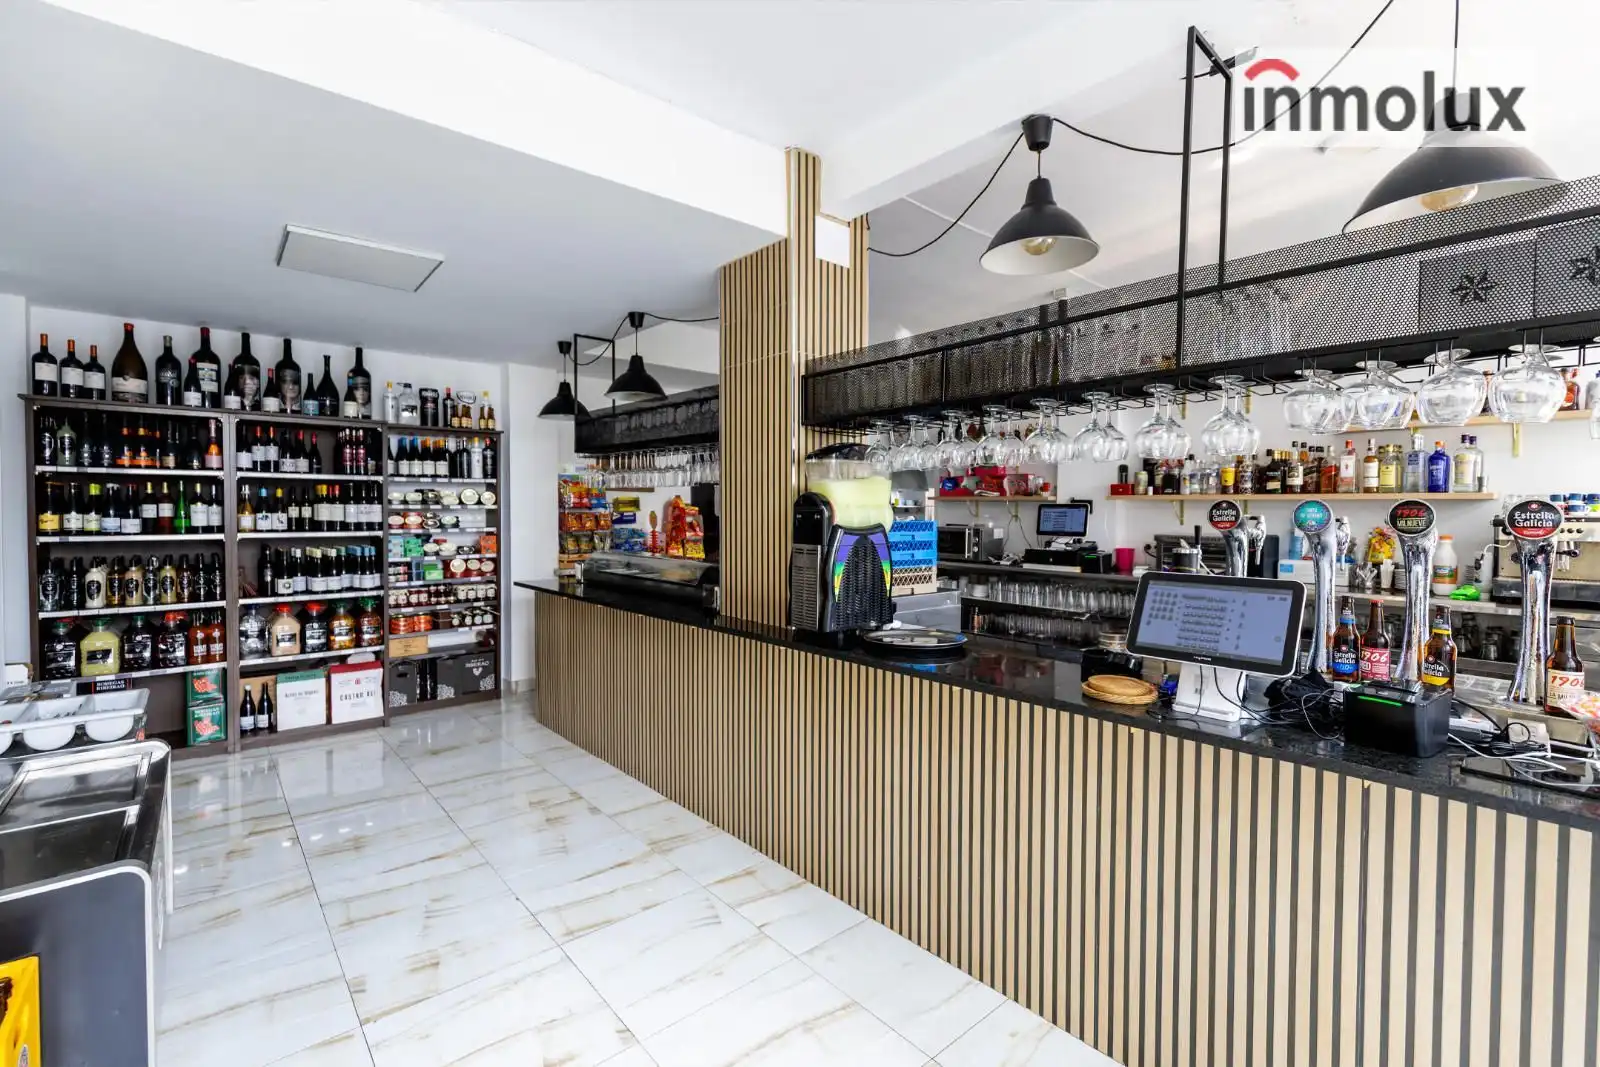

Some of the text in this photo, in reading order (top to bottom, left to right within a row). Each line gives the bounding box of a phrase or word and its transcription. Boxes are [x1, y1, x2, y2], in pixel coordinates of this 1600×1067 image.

[1396, 508, 1427, 517] 1906
[1513, 511, 1555, 520] Estrella
[1514, 519, 1553, 527] Galicia
[1361, 651, 1389, 662] 1906
[1423, 662, 1444, 671] trella
